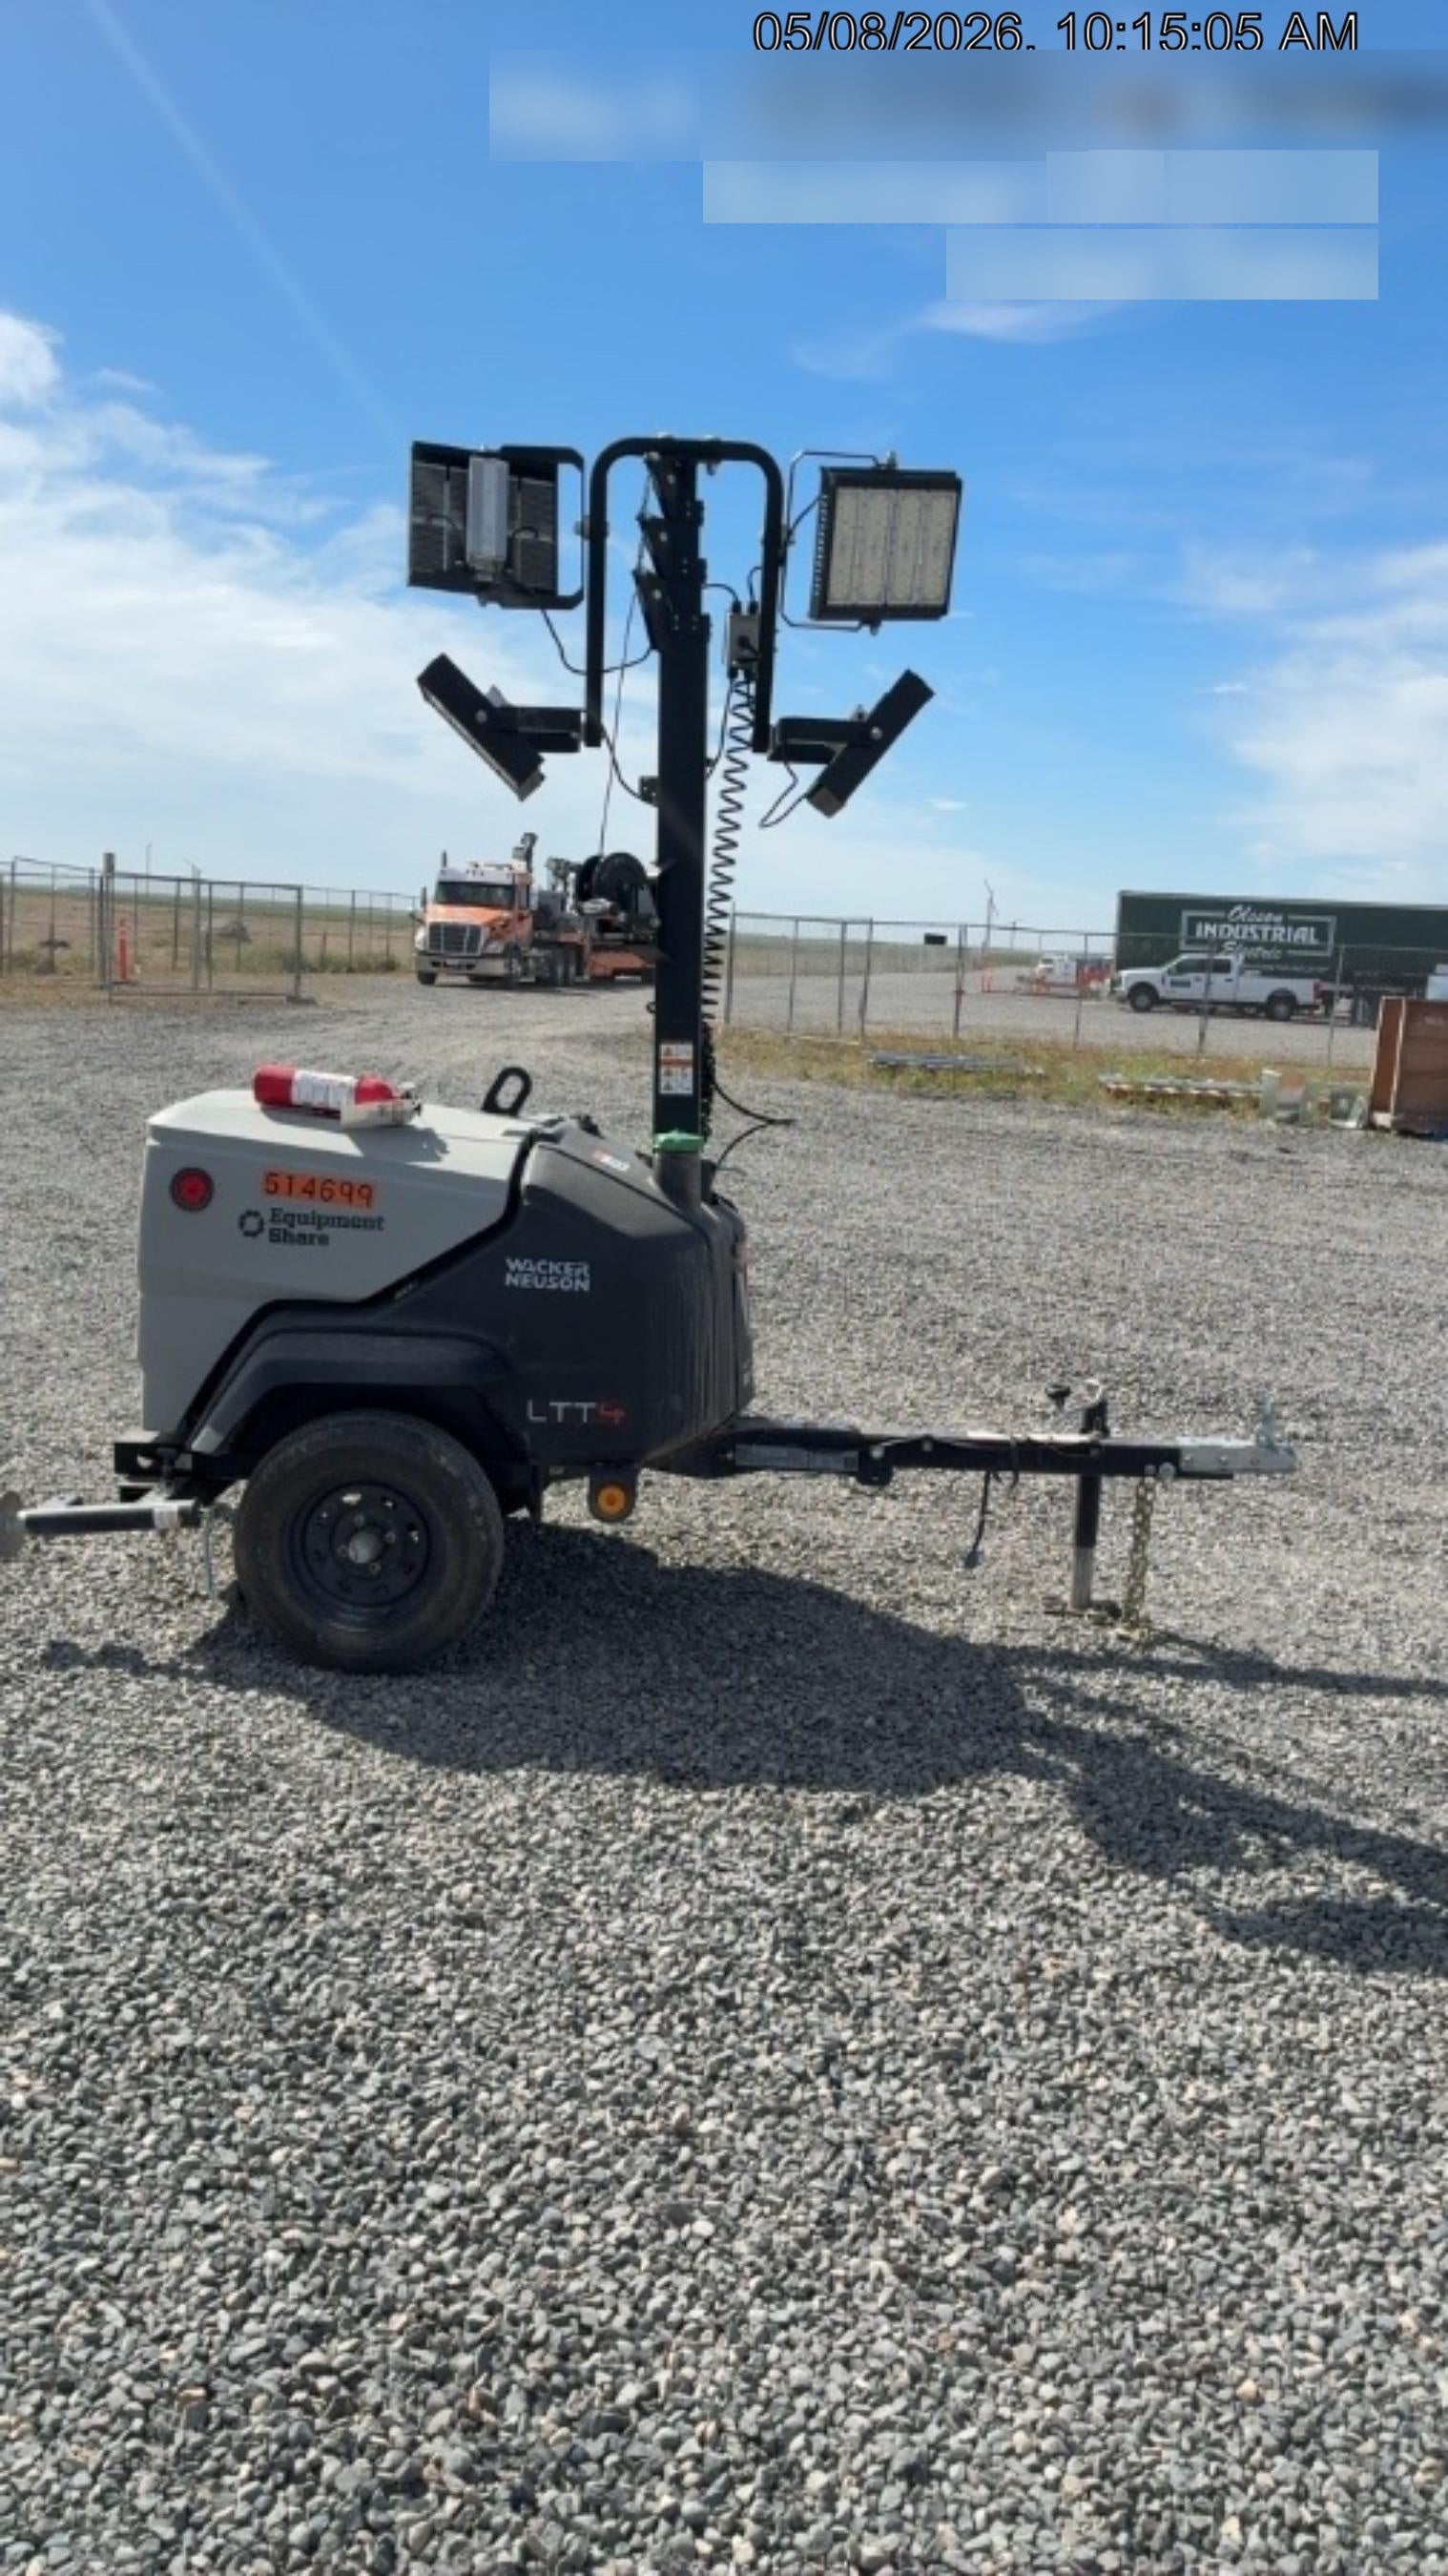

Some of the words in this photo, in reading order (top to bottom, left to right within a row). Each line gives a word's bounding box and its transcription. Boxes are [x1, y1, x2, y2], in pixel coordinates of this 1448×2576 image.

[1195, 922, 1320, 945] INDUSTRIAL
[264, 1171, 374, 1209] 514699
[268, 1207, 384, 1231] Equipment
[268, 1227, 330, 1246] Share
[506, 1257, 590, 1278] WACKER
[505, 1273, 590, 1292] NEUSON
[527, 1399, 626, 1425] LTT4
